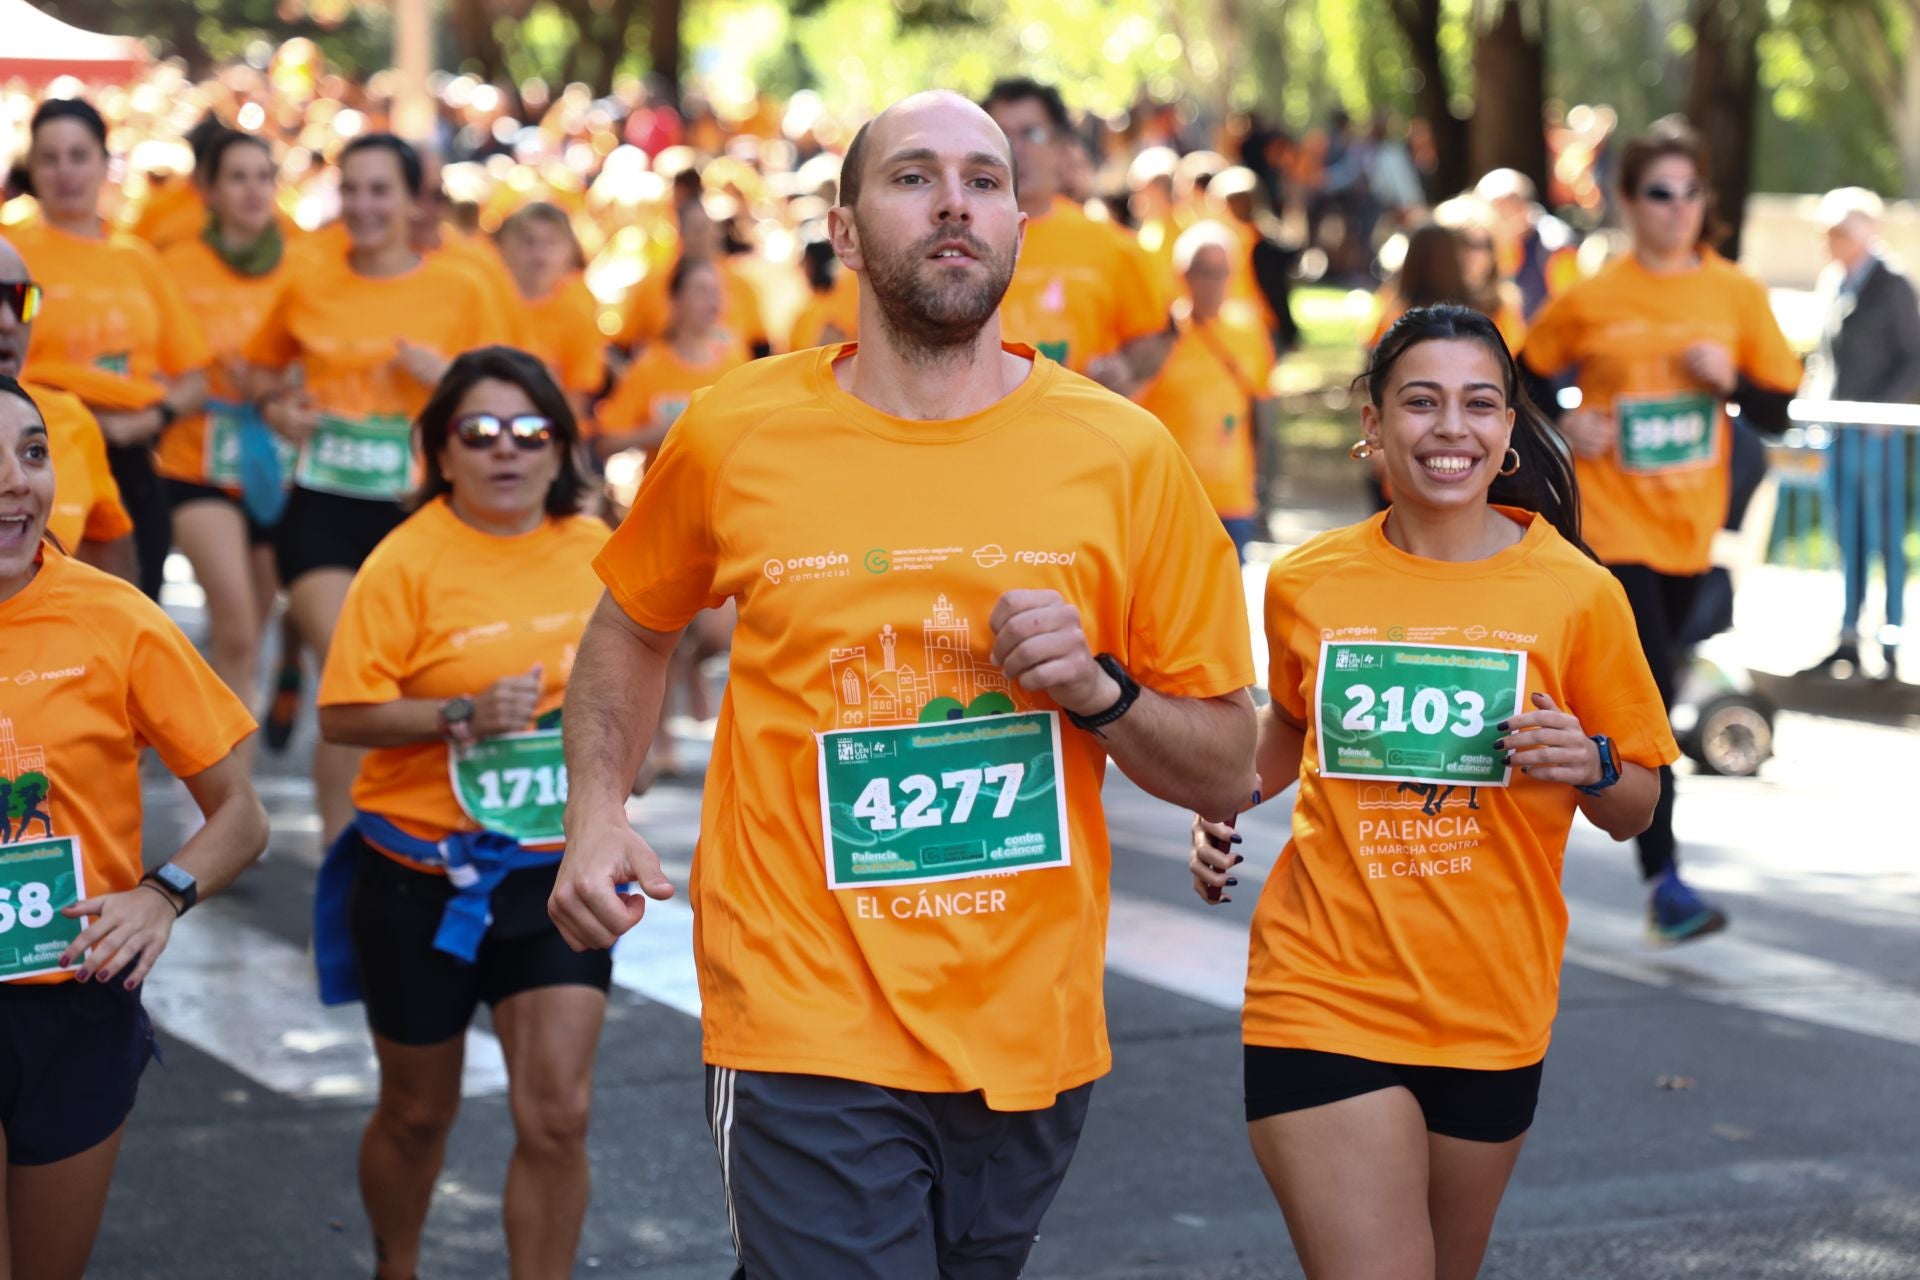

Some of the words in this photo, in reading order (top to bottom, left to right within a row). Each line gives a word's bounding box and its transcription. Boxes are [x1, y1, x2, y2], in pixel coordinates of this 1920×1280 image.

[787, 551, 848, 570] oregón
[1014, 547, 1076, 566] repsol
[790, 568, 850, 583] comercial
[1336, 625, 1377, 636] oregón
[1492, 628, 1538, 645] repsol
[41, 665, 85, 681] repsol
[1342, 684, 1485, 738] 2103
[1461, 754, 1493, 764] contra
[853, 762, 1025, 831] 4277
[1358, 816, 1481, 842] PALENCIA
[1004, 833, 1044, 847] contra
[1360, 846, 1373, 856] EN
[1377, 844, 1426, 856] MARCHA
[1429, 839, 1479, 853] CONTRA
[852, 850, 898, 863] Palencia
[991, 846, 1003, 860] el
[1004, 844, 1046, 859] cáncer
[1368, 862, 1387, 879] EL
[1392, 856, 1472, 879] CÁNCER
[857, 896, 884, 919] EL
[891, 888, 1007, 919] CÁNCER
